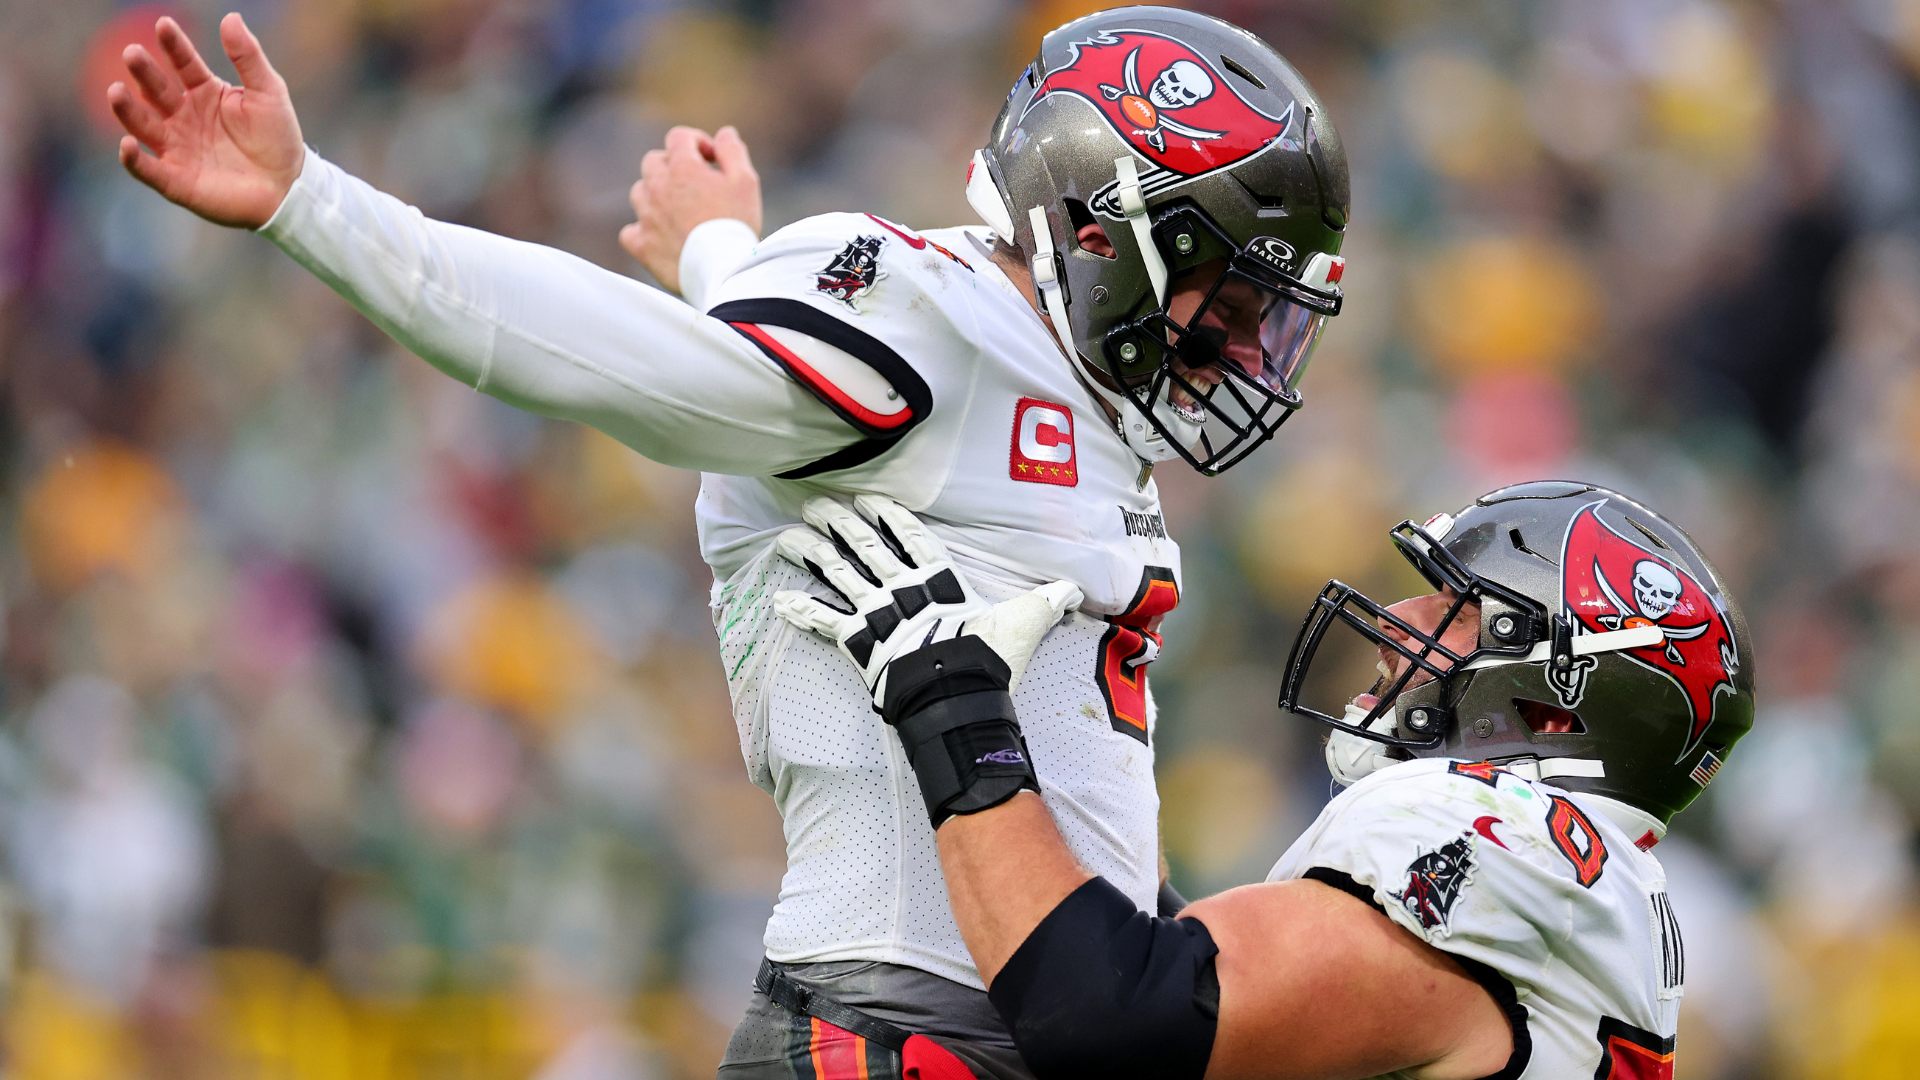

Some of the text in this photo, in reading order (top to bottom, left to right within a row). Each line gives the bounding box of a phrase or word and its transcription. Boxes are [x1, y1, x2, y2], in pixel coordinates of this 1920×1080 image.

[1250, 244, 1294, 273] OAKLEY
[1019, 405, 1072, 464] C
[1117, 504, 1166, 545] BUCCAN
